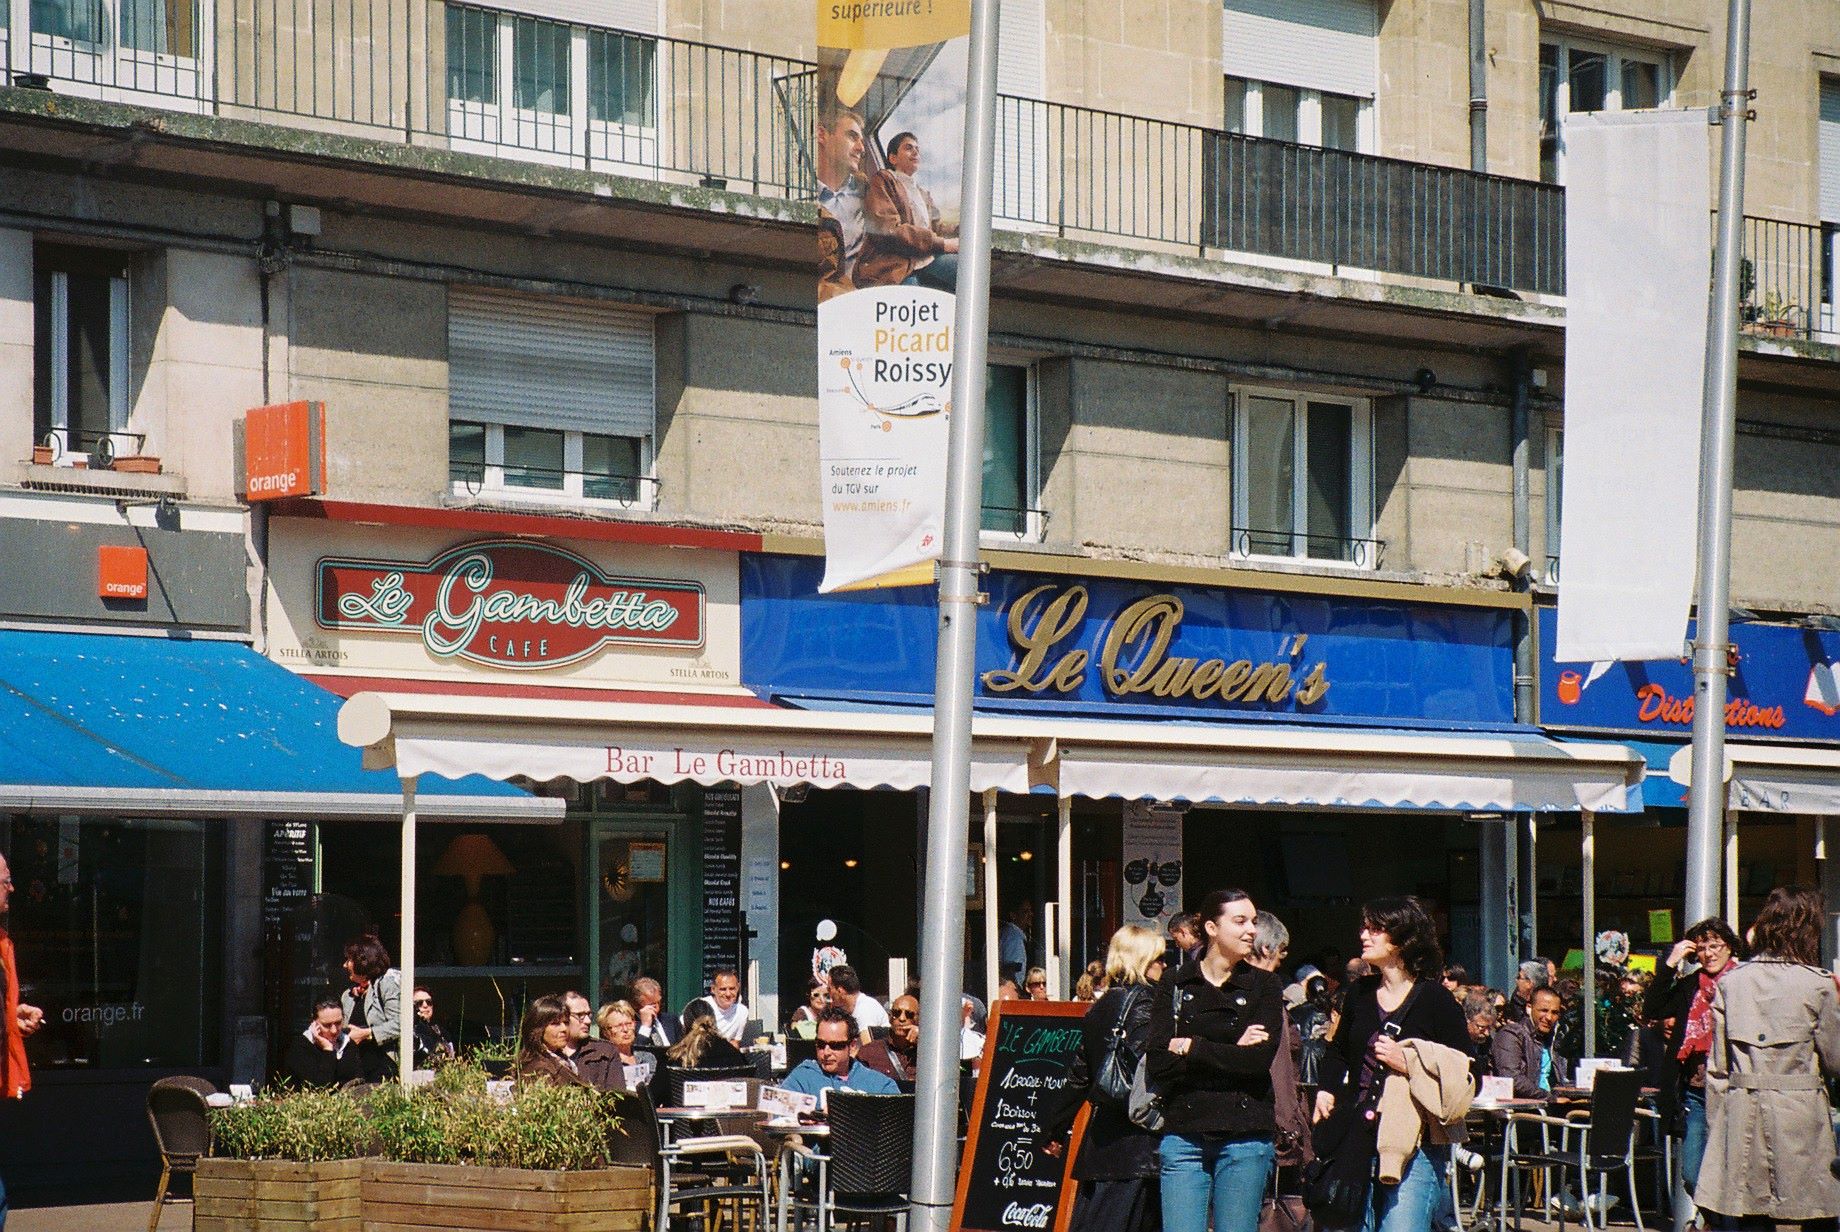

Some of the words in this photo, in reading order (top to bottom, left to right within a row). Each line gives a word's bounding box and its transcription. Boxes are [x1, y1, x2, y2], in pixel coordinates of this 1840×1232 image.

[875, 299, 939, 328] Projet
[874, 326, 949, 353] Picard
[874, 356, 952, 388] Roissy
[249, 471, 297, 493] orange
[831, 465, 871, 476] Soutenez
[875, 465, 883, 476] le
[887, 465, 918, 478] projet
[832, 483, 843, 494] du
[846, 483, 861, 494] TGV
[864, 484, 878, 494] sur
[832, 499, 911, 513] www.amiens.fr
[106, 583, 143, 596] orange
[338, 571, 414, 624] Le
[422, 551, 679, 656] Gambetta
[280, 648, 312, 659] STELLA
[315, 650, 348, 660] ARTOIS
[488, 635, 550, 658] CAFE
[980, 584, 1089, 692] Le
[1102, 594, 1331, 705] Queen's
[670, 668, 698, 678] STELLA
[700, 670, 729, 679] ARTOIS
[604, 746, 653, 774] Bar
[673, 747, 707, 776] Le
[716, 749, 847, 779] Gambetta
[62, 1001, 145, 1026] orange.fr
